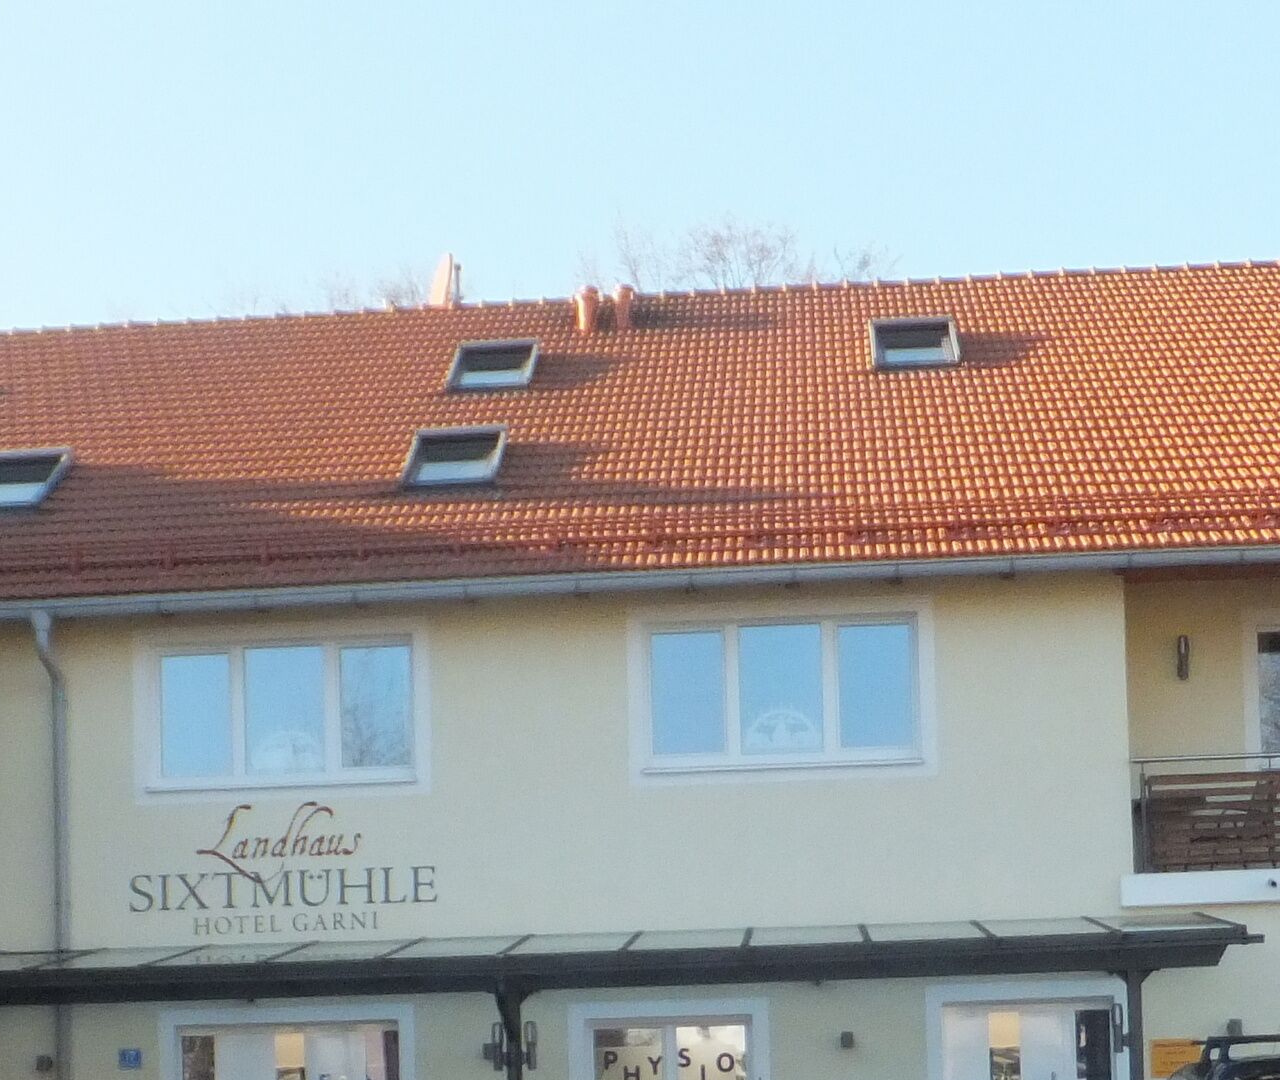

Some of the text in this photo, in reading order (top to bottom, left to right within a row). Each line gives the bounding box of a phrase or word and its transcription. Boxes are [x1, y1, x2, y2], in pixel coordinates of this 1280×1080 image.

[196, 801, 361, 883] Landhaus
[129, 865, 437, 912] SIXTMÜHLE
[193, 911, 378, 936] HOTEL GARNI
